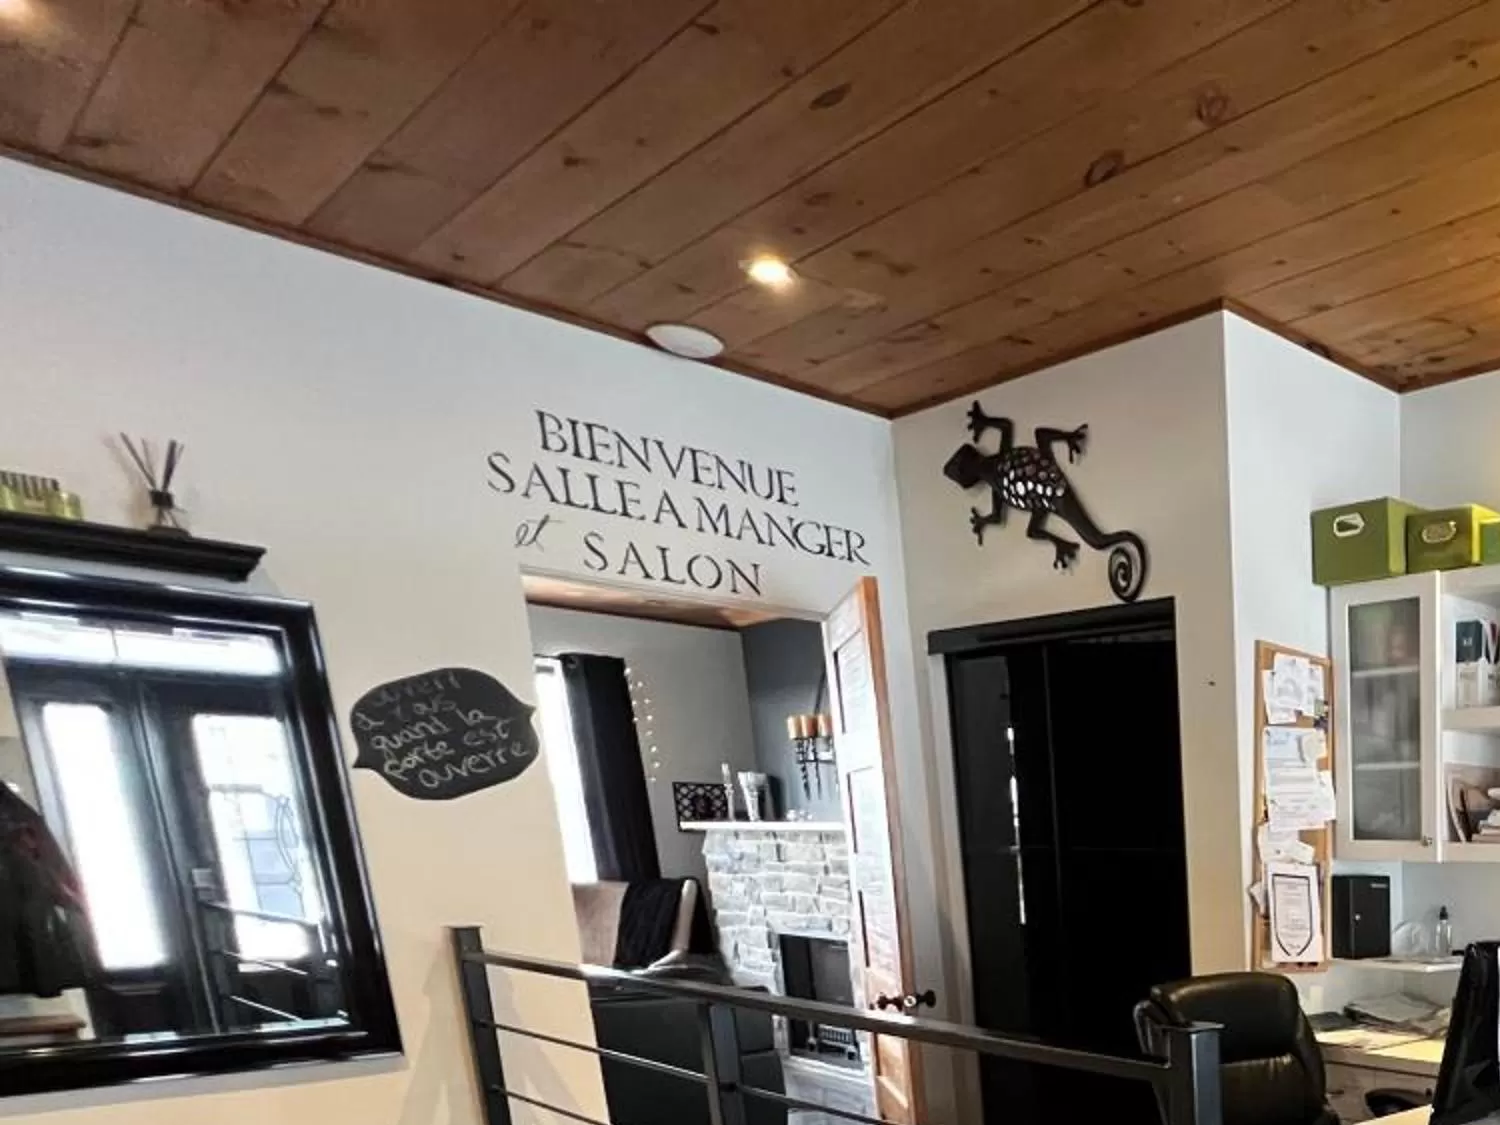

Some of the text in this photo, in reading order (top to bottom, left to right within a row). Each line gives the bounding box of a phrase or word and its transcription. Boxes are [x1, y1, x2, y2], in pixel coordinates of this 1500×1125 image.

[486, 450, 872, 566] SALLE A MANGER
[535, 409, 800, 508] BIENVENUE
[513, 512, 763, 597] et SALON
